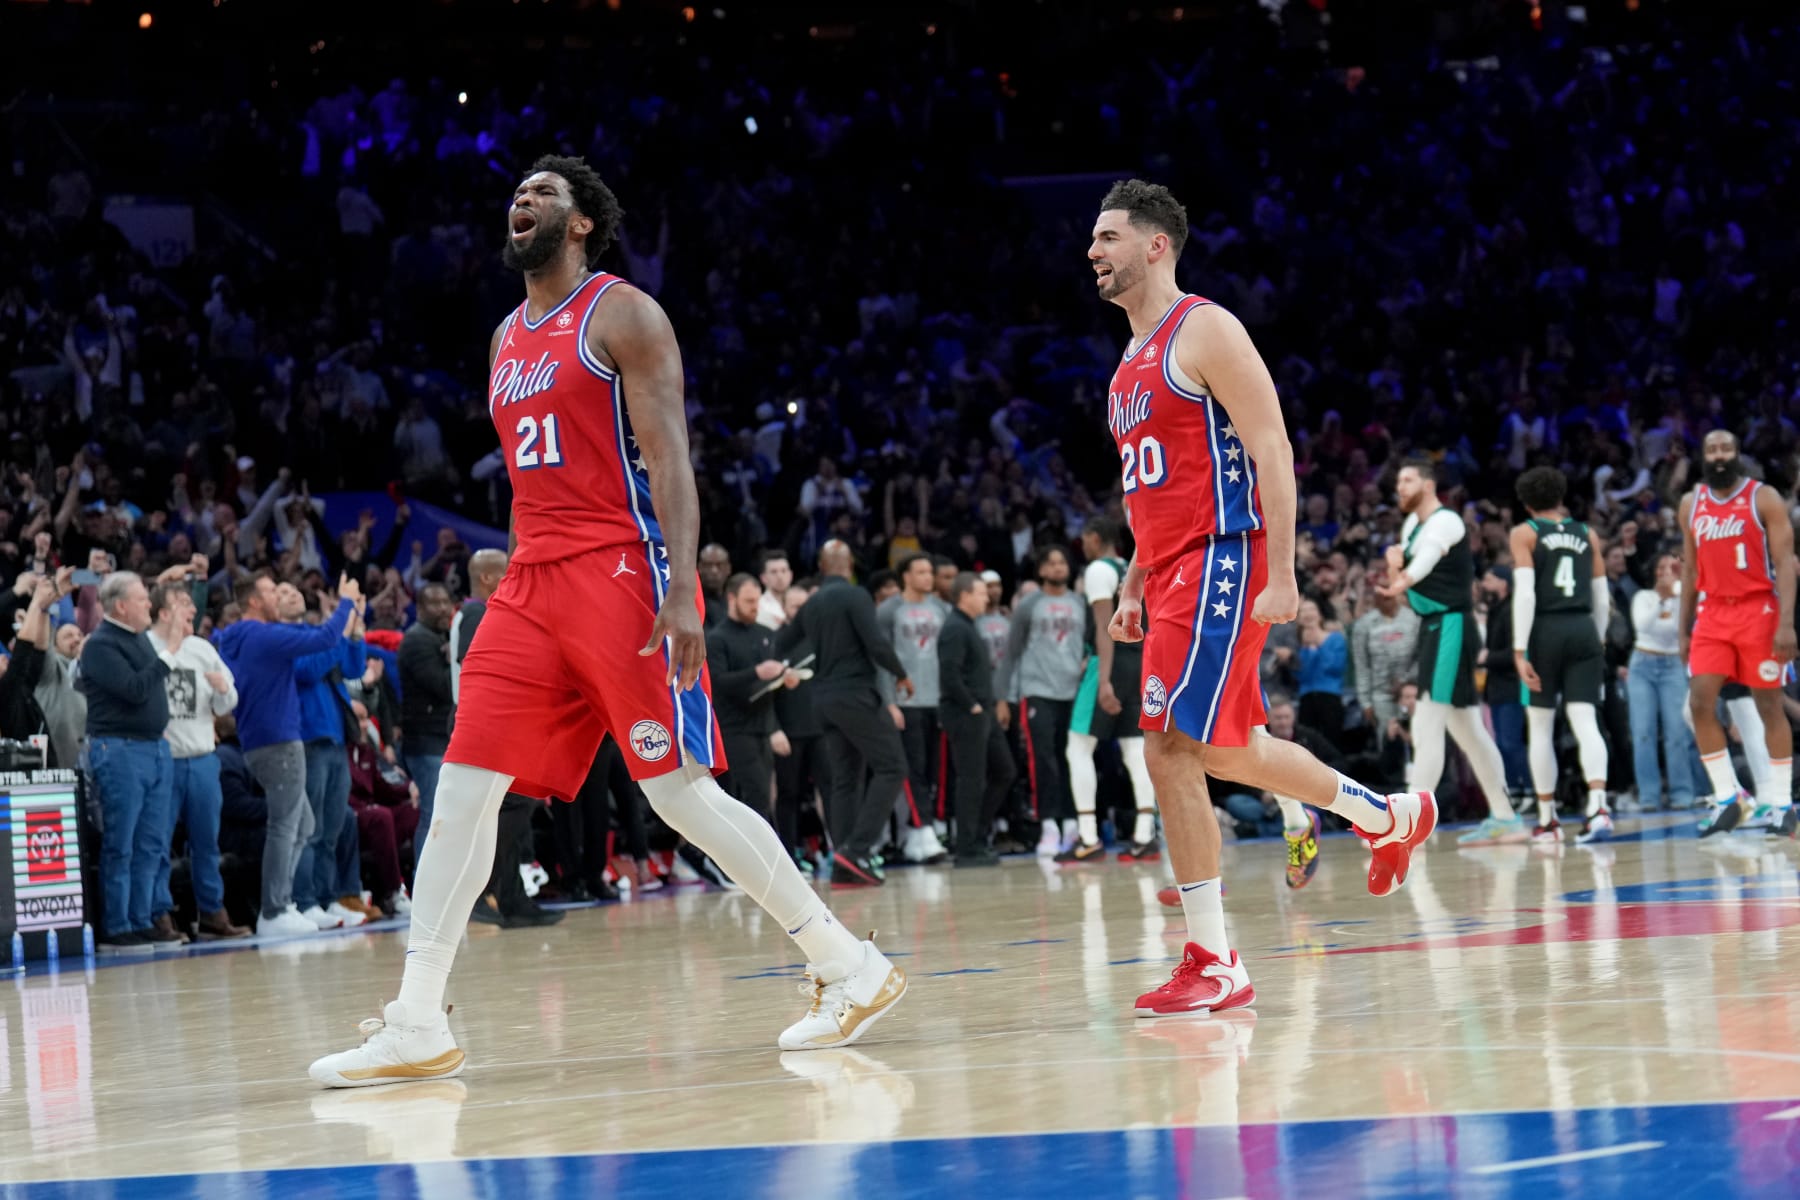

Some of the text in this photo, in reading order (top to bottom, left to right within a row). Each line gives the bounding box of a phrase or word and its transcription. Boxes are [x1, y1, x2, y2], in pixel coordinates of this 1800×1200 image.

[490, 352, 561, 412] Phila
[515, 413, 563, 469] 21
[1121, 436, 1166, 494] 20
[1694, 514, 1746, 545] Phila
[1736, 542, 1748, 570] 1
[1554, 556, 1576, 597] 4
[633, 736, 668, 752] 76ers
[20, 895, 77, 919] TOYOTA
